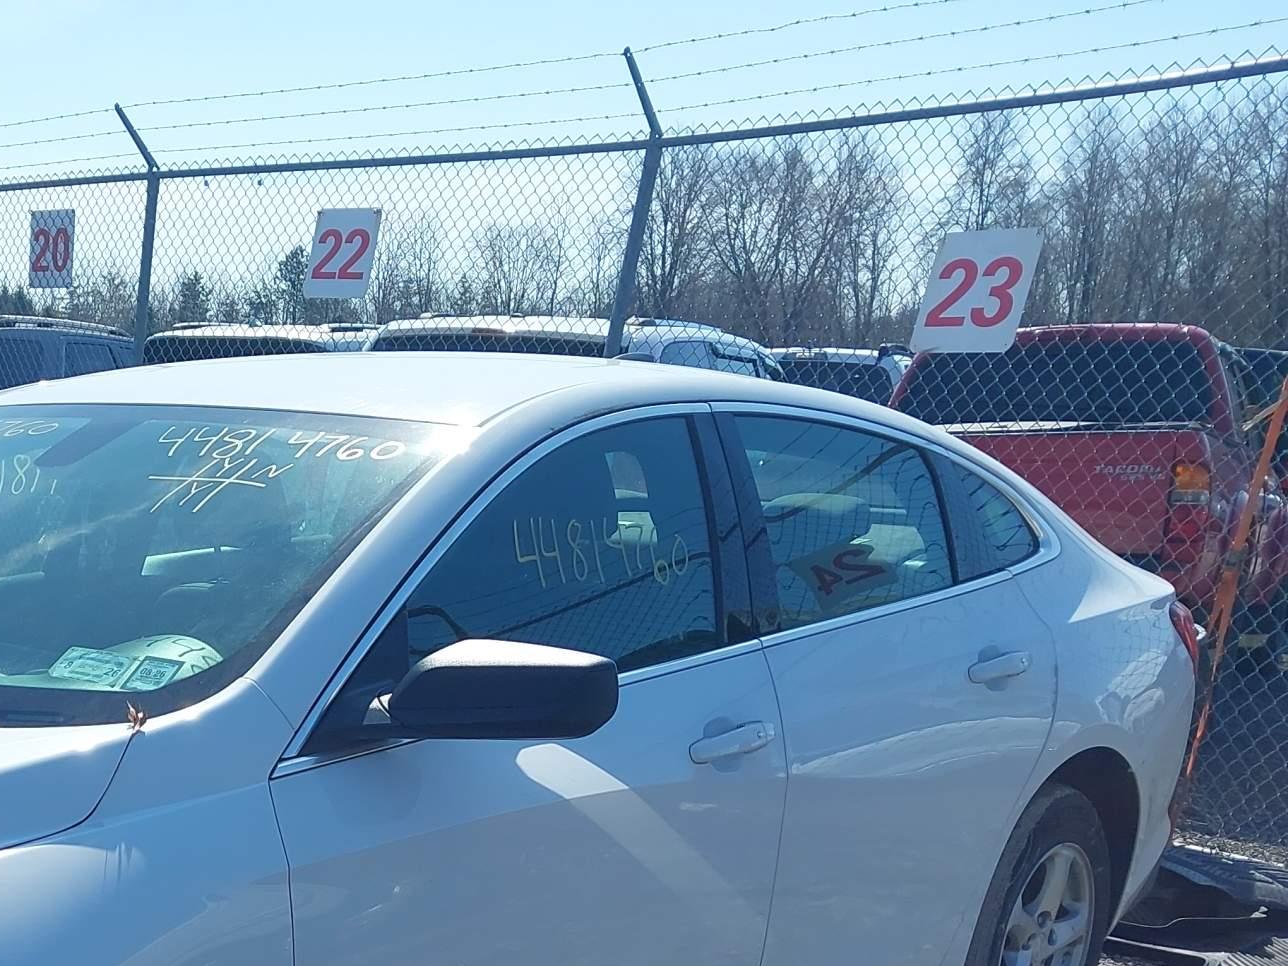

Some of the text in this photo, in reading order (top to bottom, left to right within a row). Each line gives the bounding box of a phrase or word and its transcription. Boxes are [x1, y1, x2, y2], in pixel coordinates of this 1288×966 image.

[32, 228, 70, 273] 20
[311, 228, 371, 280] 22
[924, 256, 1024, 328] 23
[159, 426, 407, 461] 4481 4760
[513, 516, 689, 590] 44814760
